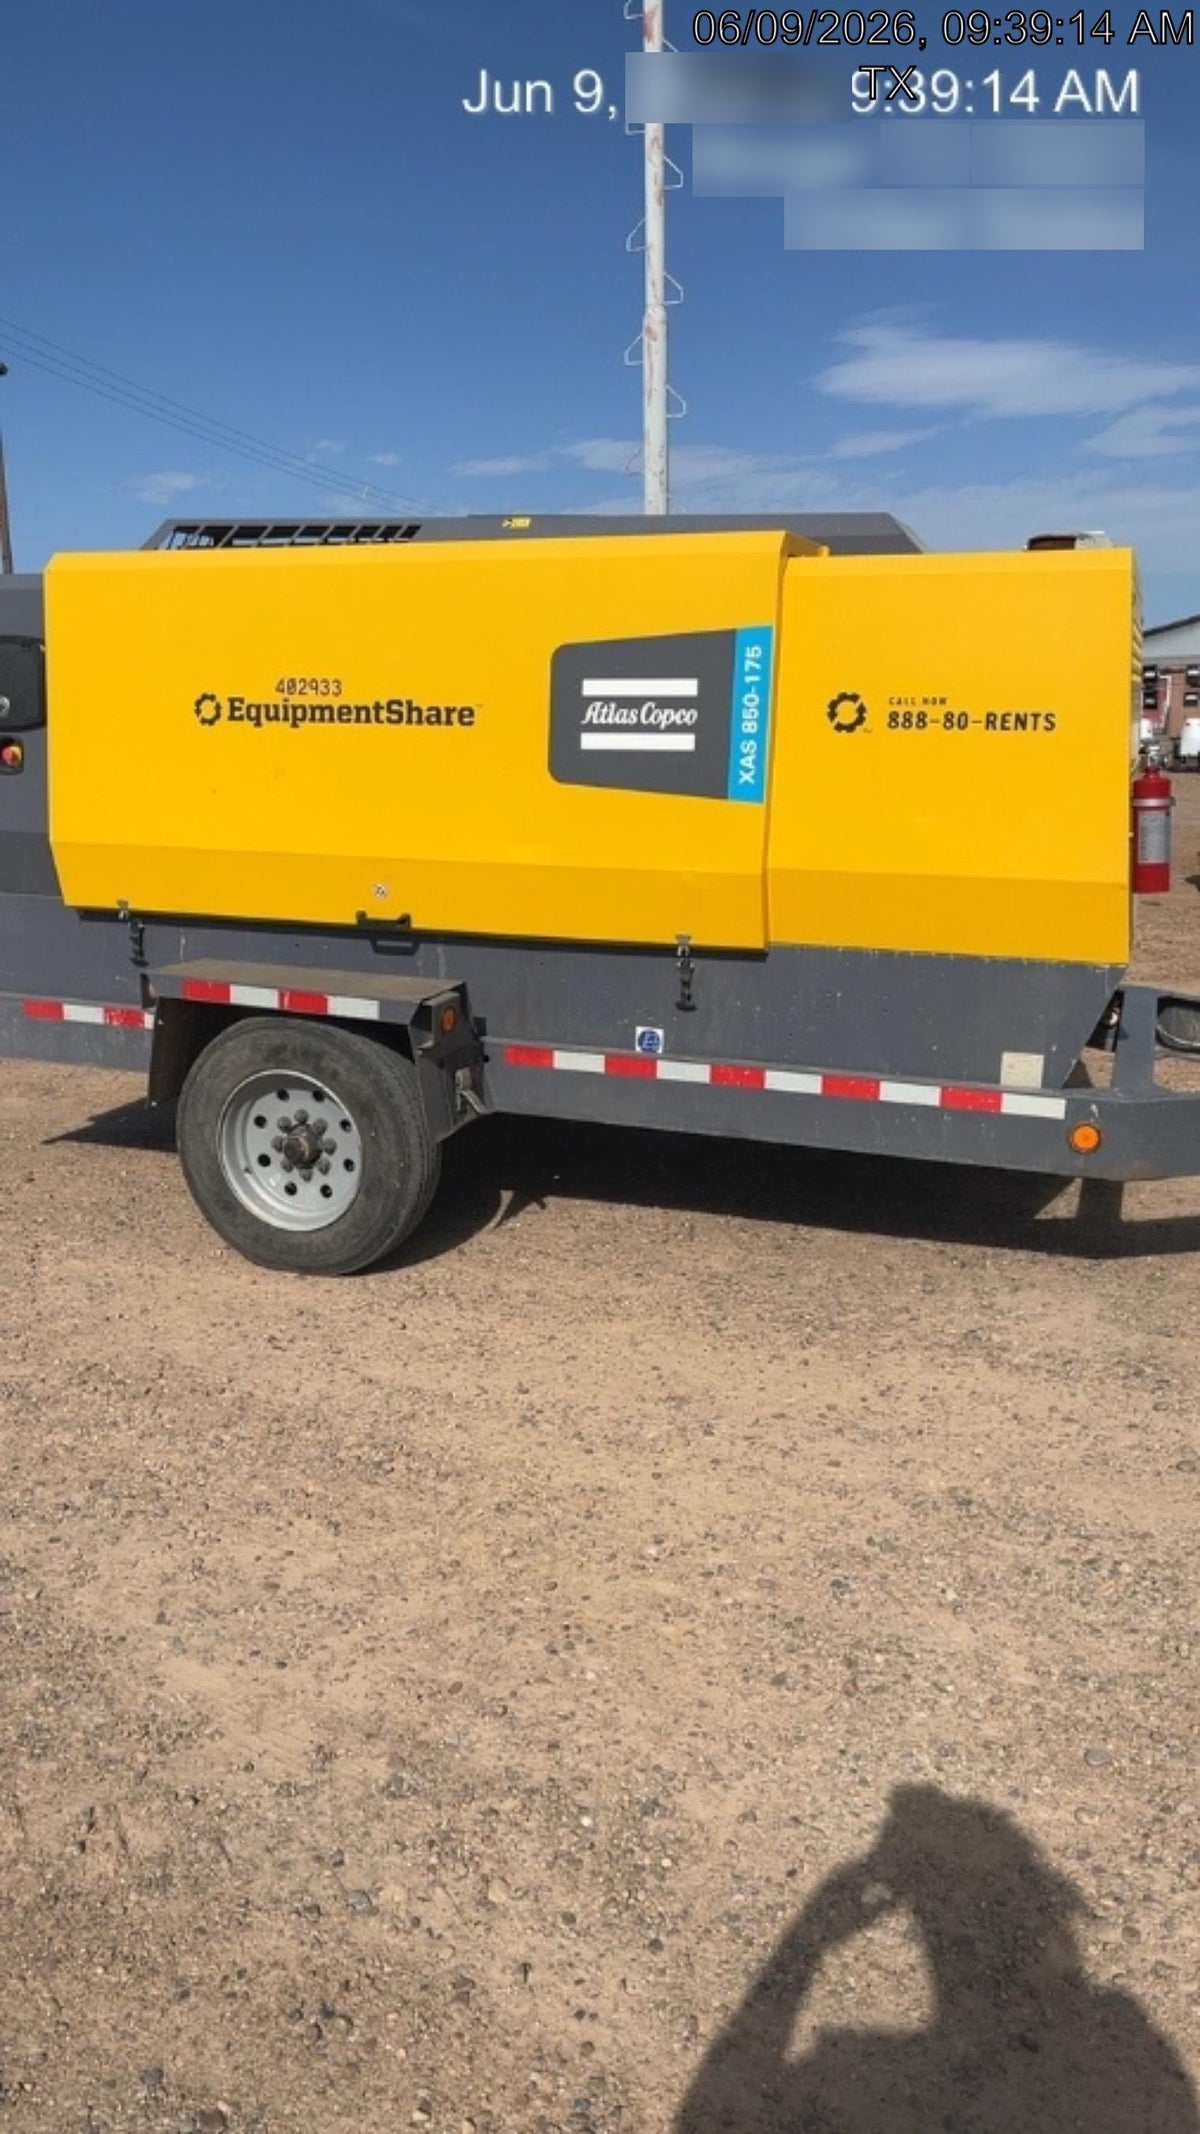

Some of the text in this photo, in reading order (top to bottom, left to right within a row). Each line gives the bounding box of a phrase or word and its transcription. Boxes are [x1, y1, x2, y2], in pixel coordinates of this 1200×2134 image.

[275, 678, 343, 697] 402933
[227, 697, 475, 728] EquipmentShare
[888, 697, 948, 706] CALL NOW
[581, 701, 698, 730] Atlas Copco
[738, 645, 763, 785] XAS 850-175
[887, 711, 1057, 732] 888-80-RENTS
